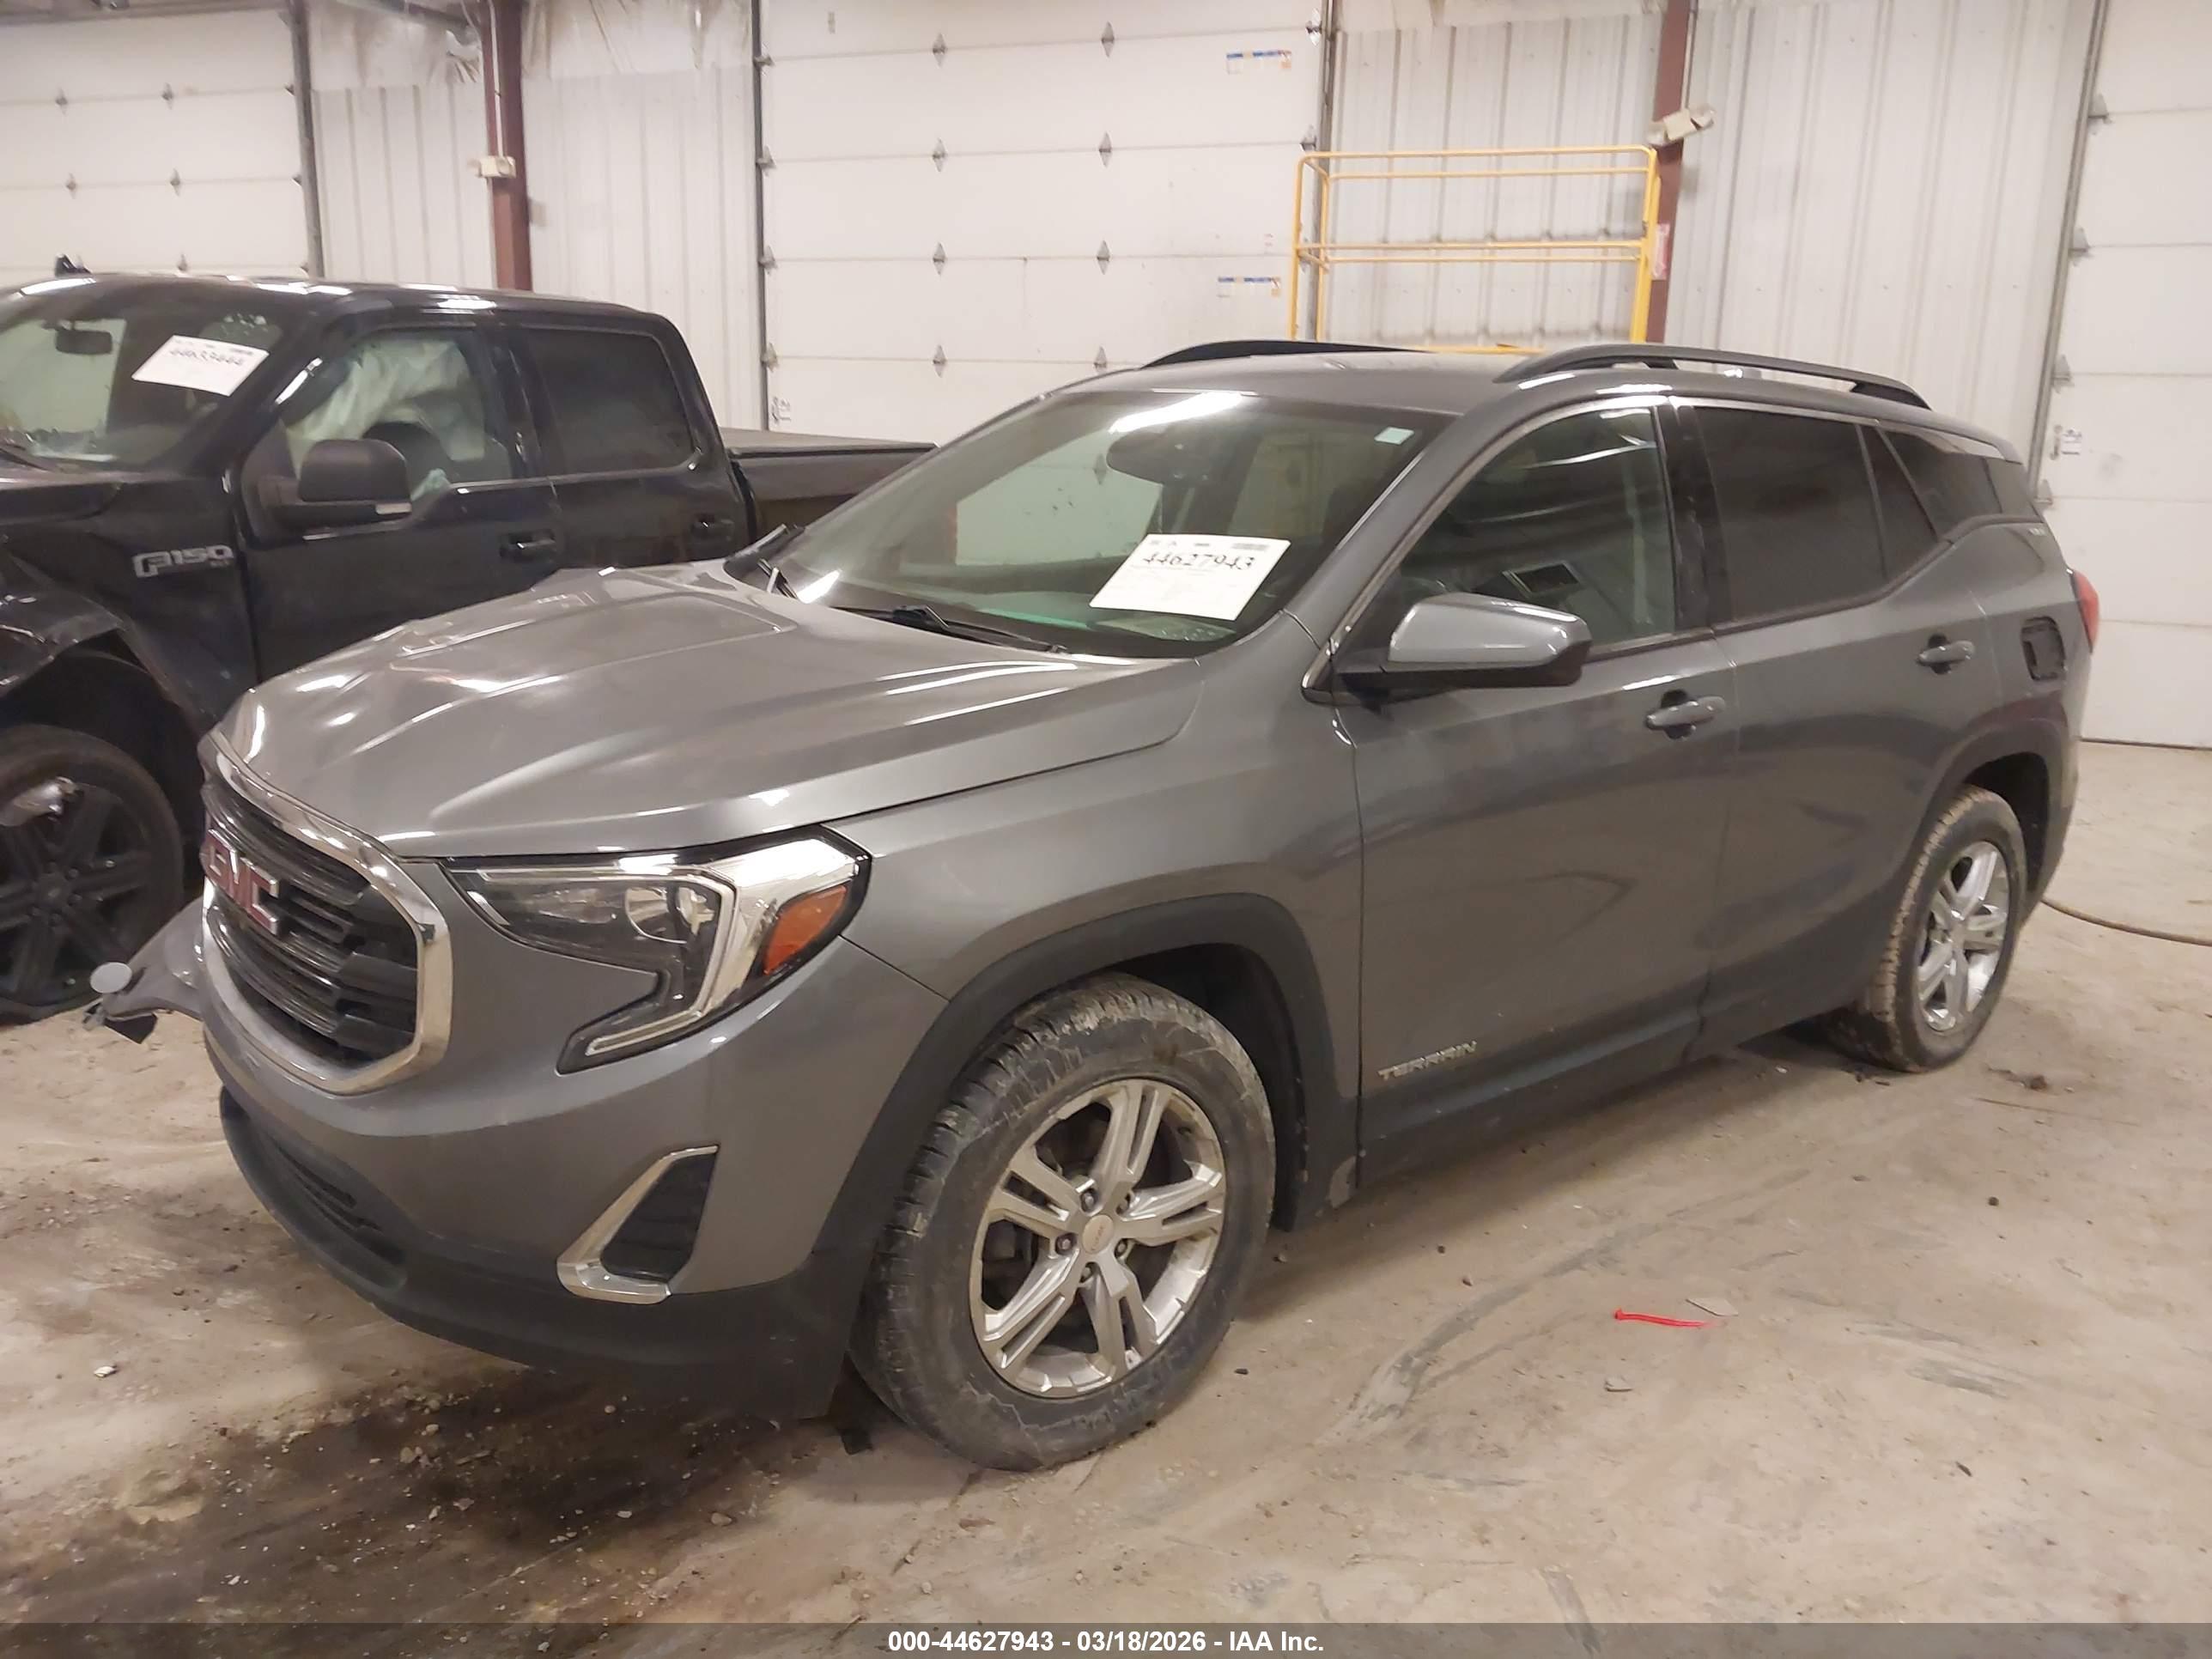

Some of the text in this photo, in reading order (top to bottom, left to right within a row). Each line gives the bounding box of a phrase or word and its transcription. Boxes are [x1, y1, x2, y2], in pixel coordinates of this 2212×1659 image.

[1143, 551, 1256, 571] 44627943
[199, 829, 279, 936] GMC
[1376, 1040, 1478, 1081] TERRAIN
